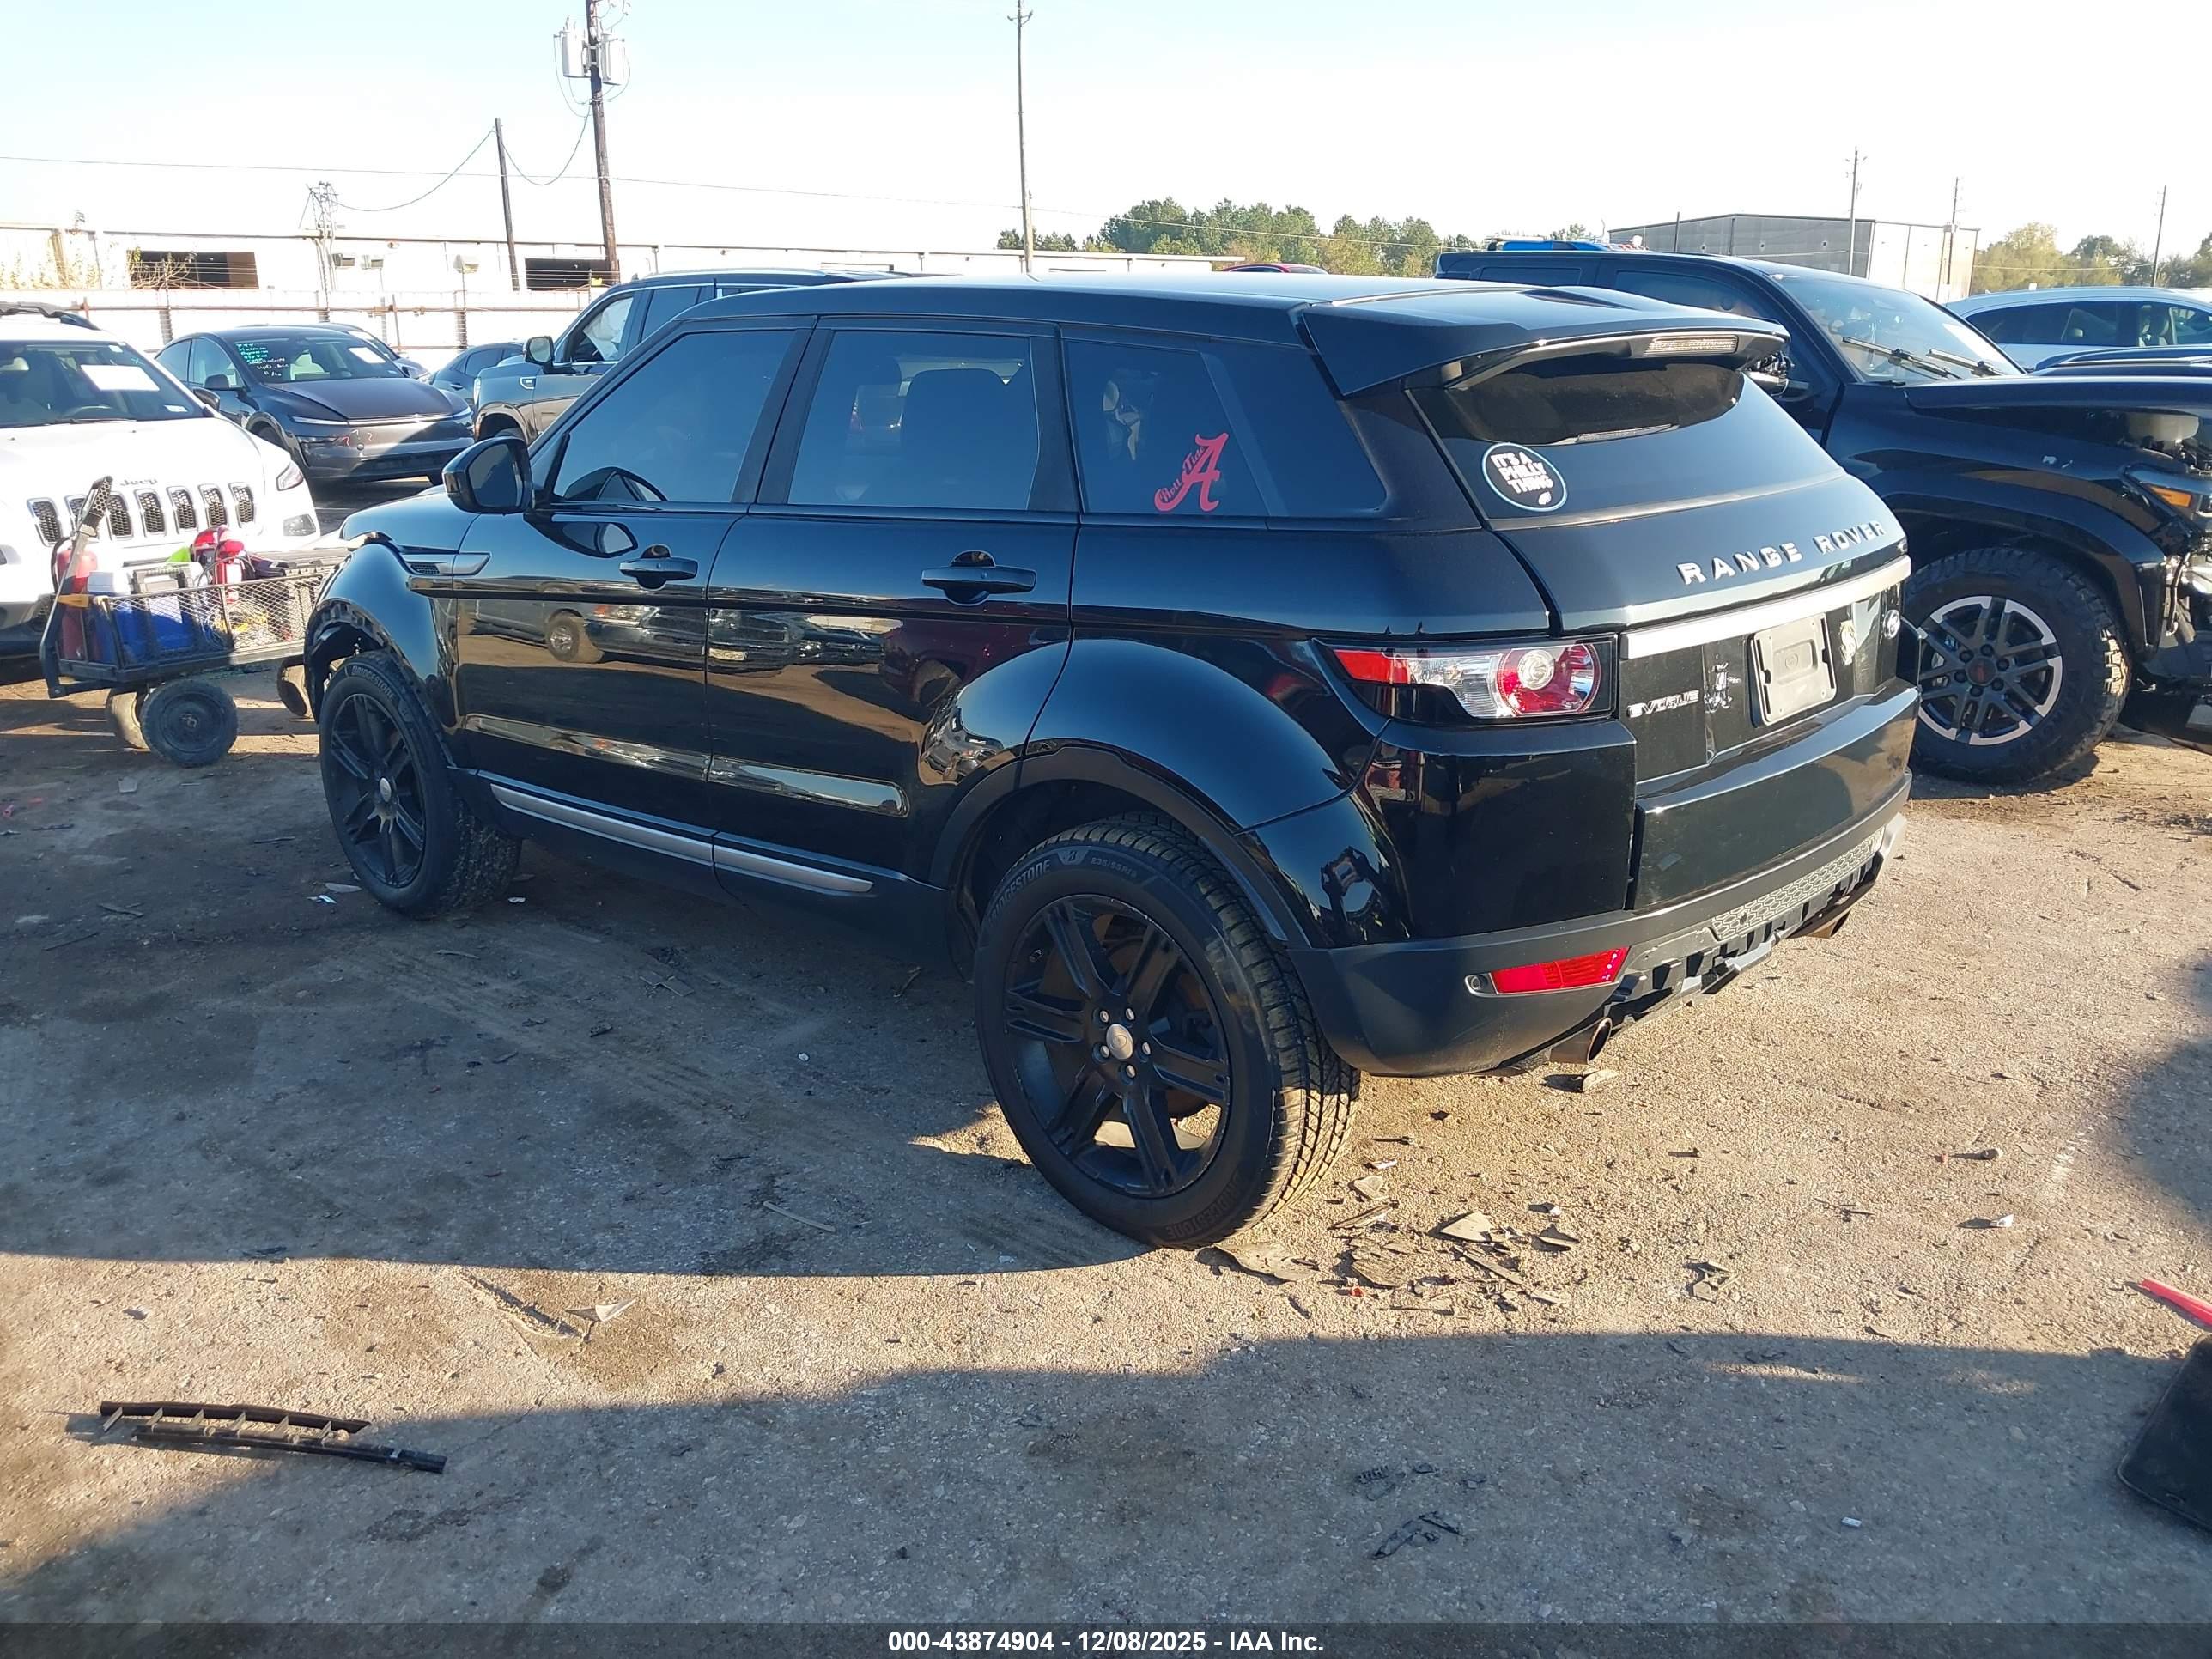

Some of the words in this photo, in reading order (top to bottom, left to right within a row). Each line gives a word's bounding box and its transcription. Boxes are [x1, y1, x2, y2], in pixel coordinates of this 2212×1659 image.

[1519, 451, 1533, 465] A
[1498, 462, 1547, 481] PHILLY
[1507, 474, 1554, 494] THING
[1676, 542, 1802, 585] RANGE
[1813, 520, 1886, 555] ROVER
[1627, 690, 1699, 718] EVOQUE
